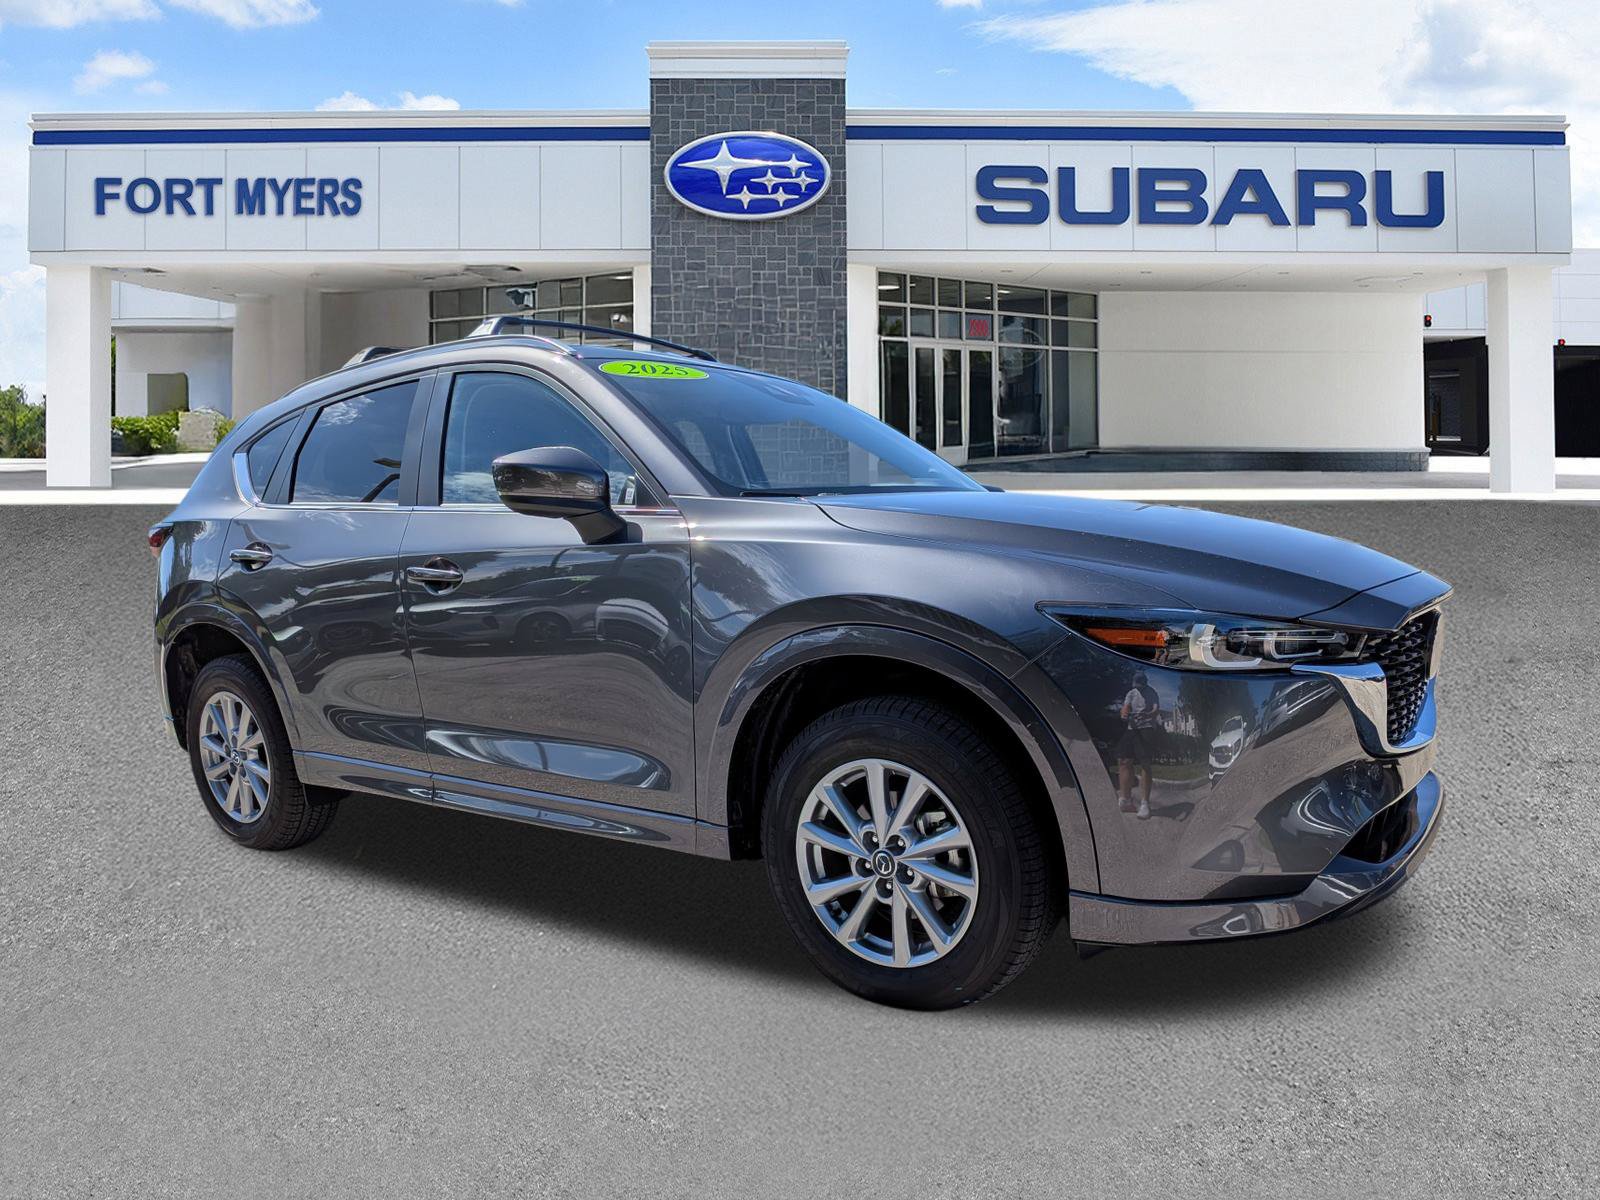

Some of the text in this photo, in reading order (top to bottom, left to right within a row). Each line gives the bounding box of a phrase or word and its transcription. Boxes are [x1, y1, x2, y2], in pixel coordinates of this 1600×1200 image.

[94, 177, 363, 217] FORT MYERS
[975, 164, 1446, 228] SUBARU
[622, 363, 689, 376] 2025
